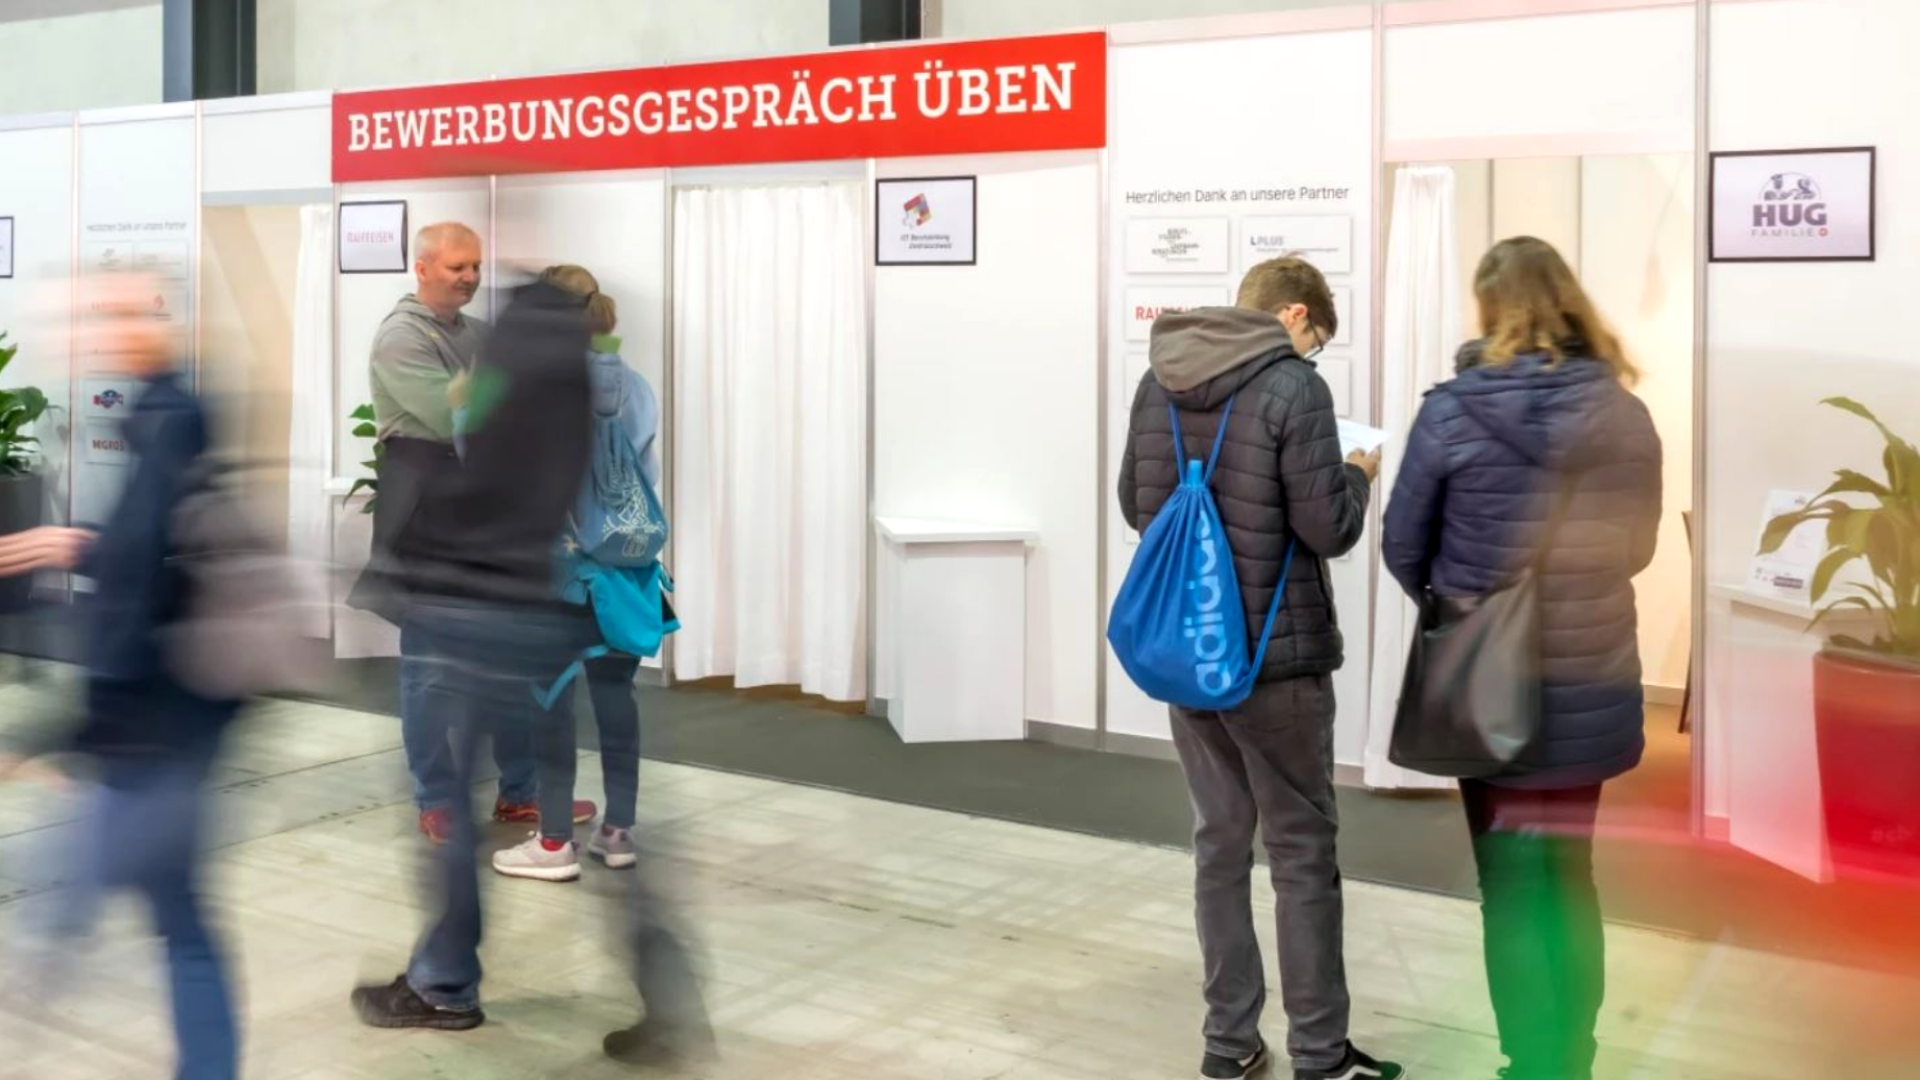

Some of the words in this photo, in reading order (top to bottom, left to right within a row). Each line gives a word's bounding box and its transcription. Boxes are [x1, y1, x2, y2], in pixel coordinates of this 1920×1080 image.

[347, 70, 897, 152] BEWERBUNGSGESPRÄCH
[913, 61, 1077, 118] ÜBEN
[1126, 190, 1191, 204] Herzlichen
[1195, 189, 1228, 202] Dank
[1230, 190, 1247, 202] an
[1250, 188, 1296, 201] unsere
[1299, 186, 1349, 200] Partner
[1752, 203, 1828, 228] HUG
[1751, 228, 1816, 238] FAMILIE
[1183, 510, 1232, 697] adidas
